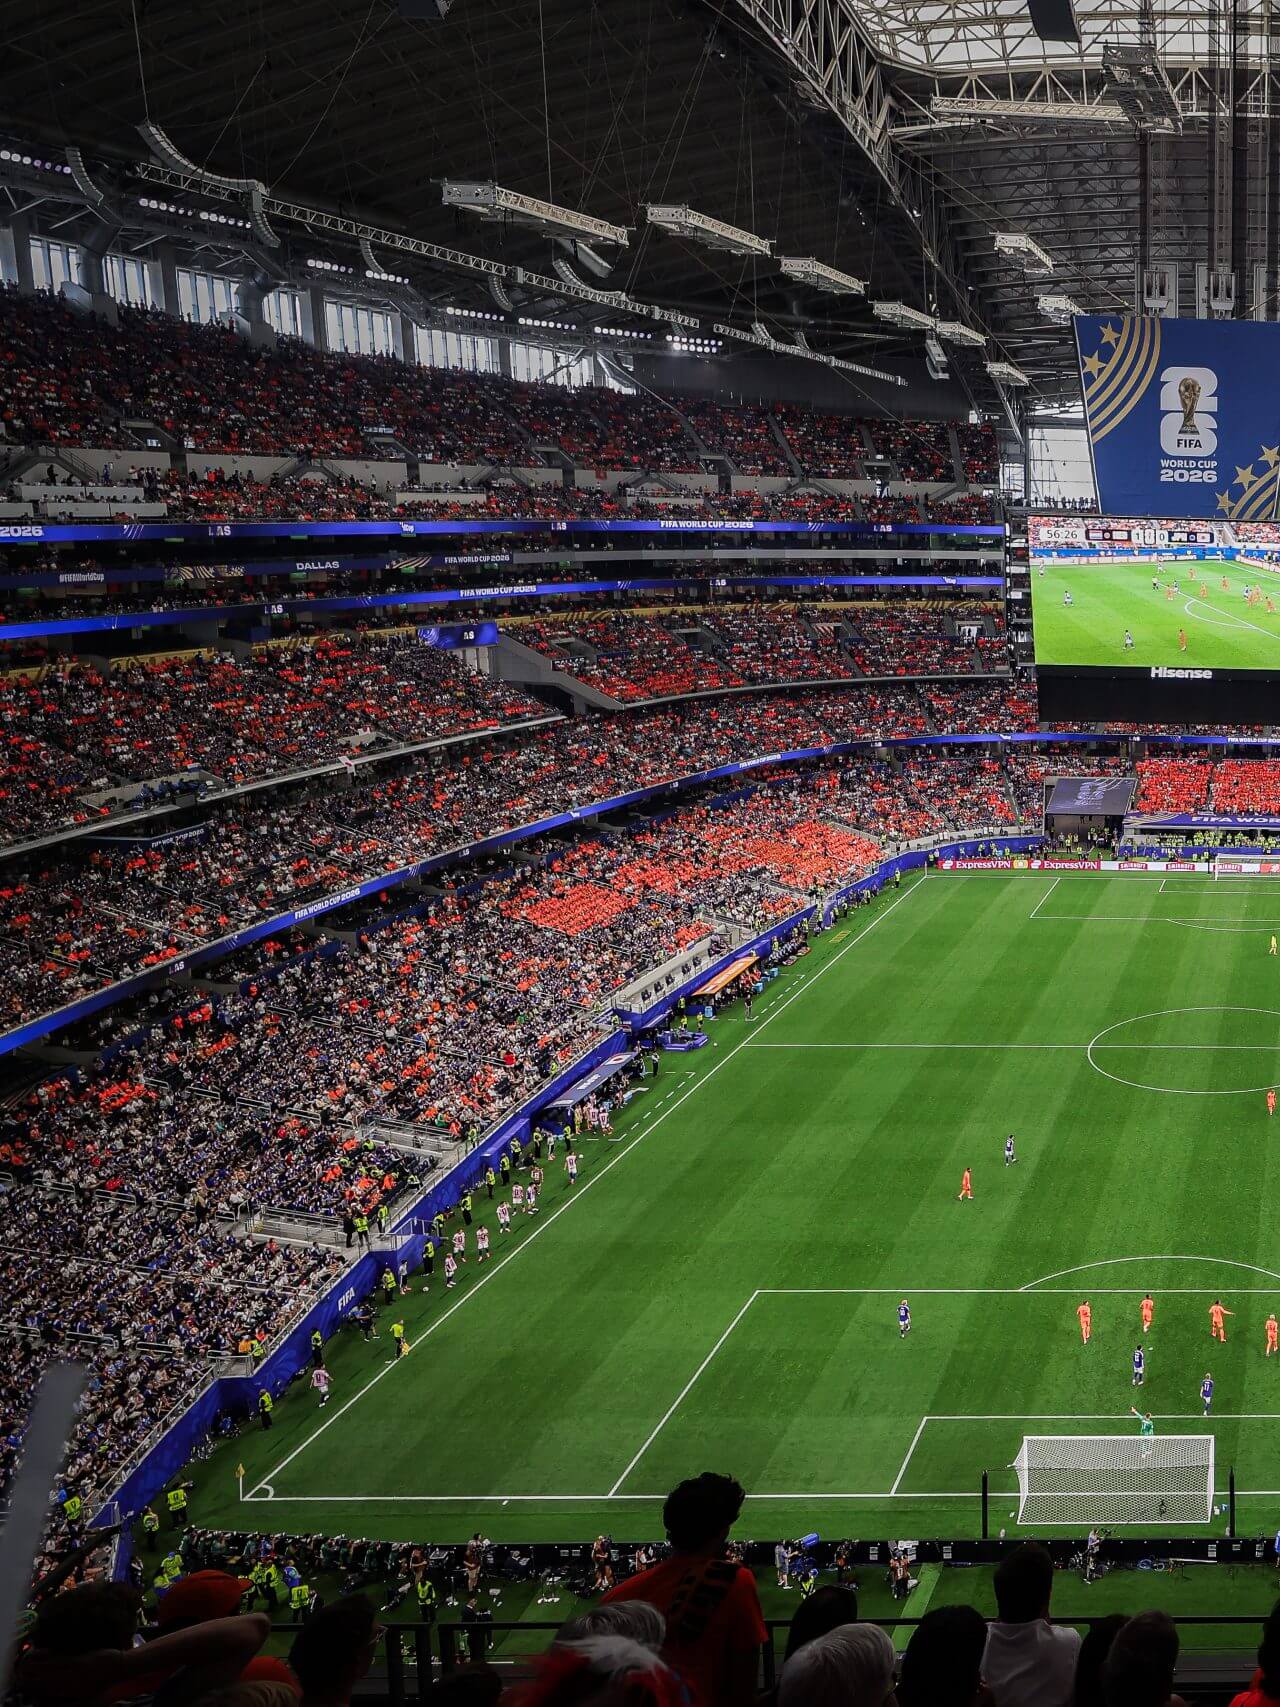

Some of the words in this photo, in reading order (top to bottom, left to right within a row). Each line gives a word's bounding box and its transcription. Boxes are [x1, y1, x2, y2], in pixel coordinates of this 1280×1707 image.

[1177, 439, 1202, 449] FIFA
[1161, 460, 1197, 468] WORLD
[1198, 460, 1218, 468] CUP
[1160, 469, 1217, 482] 2026
[0, 526, 43, 537] 2026
[1046, 530, 1078, 539] 56:26
[296, 560, 340, 571] DALLAS
[460, 588, 476, 597] FIFA
[476, 587, 499, 596] WORLD
[500, 586, 513, 594] CUP
[1151, 666, 1213, 679] Hisense
[955, 860, 1011, 870] ExpressVPN
[1043, 861, 1098, 871] ExpressVPN
[294, 908, 307, 920] FIFA
[308, 901, 328, 914] WORLD
[329, 895, 340, 906] CUP
[341, 888, 361, 901] 2026
[338, 1287, 356, 1311] FIFA
